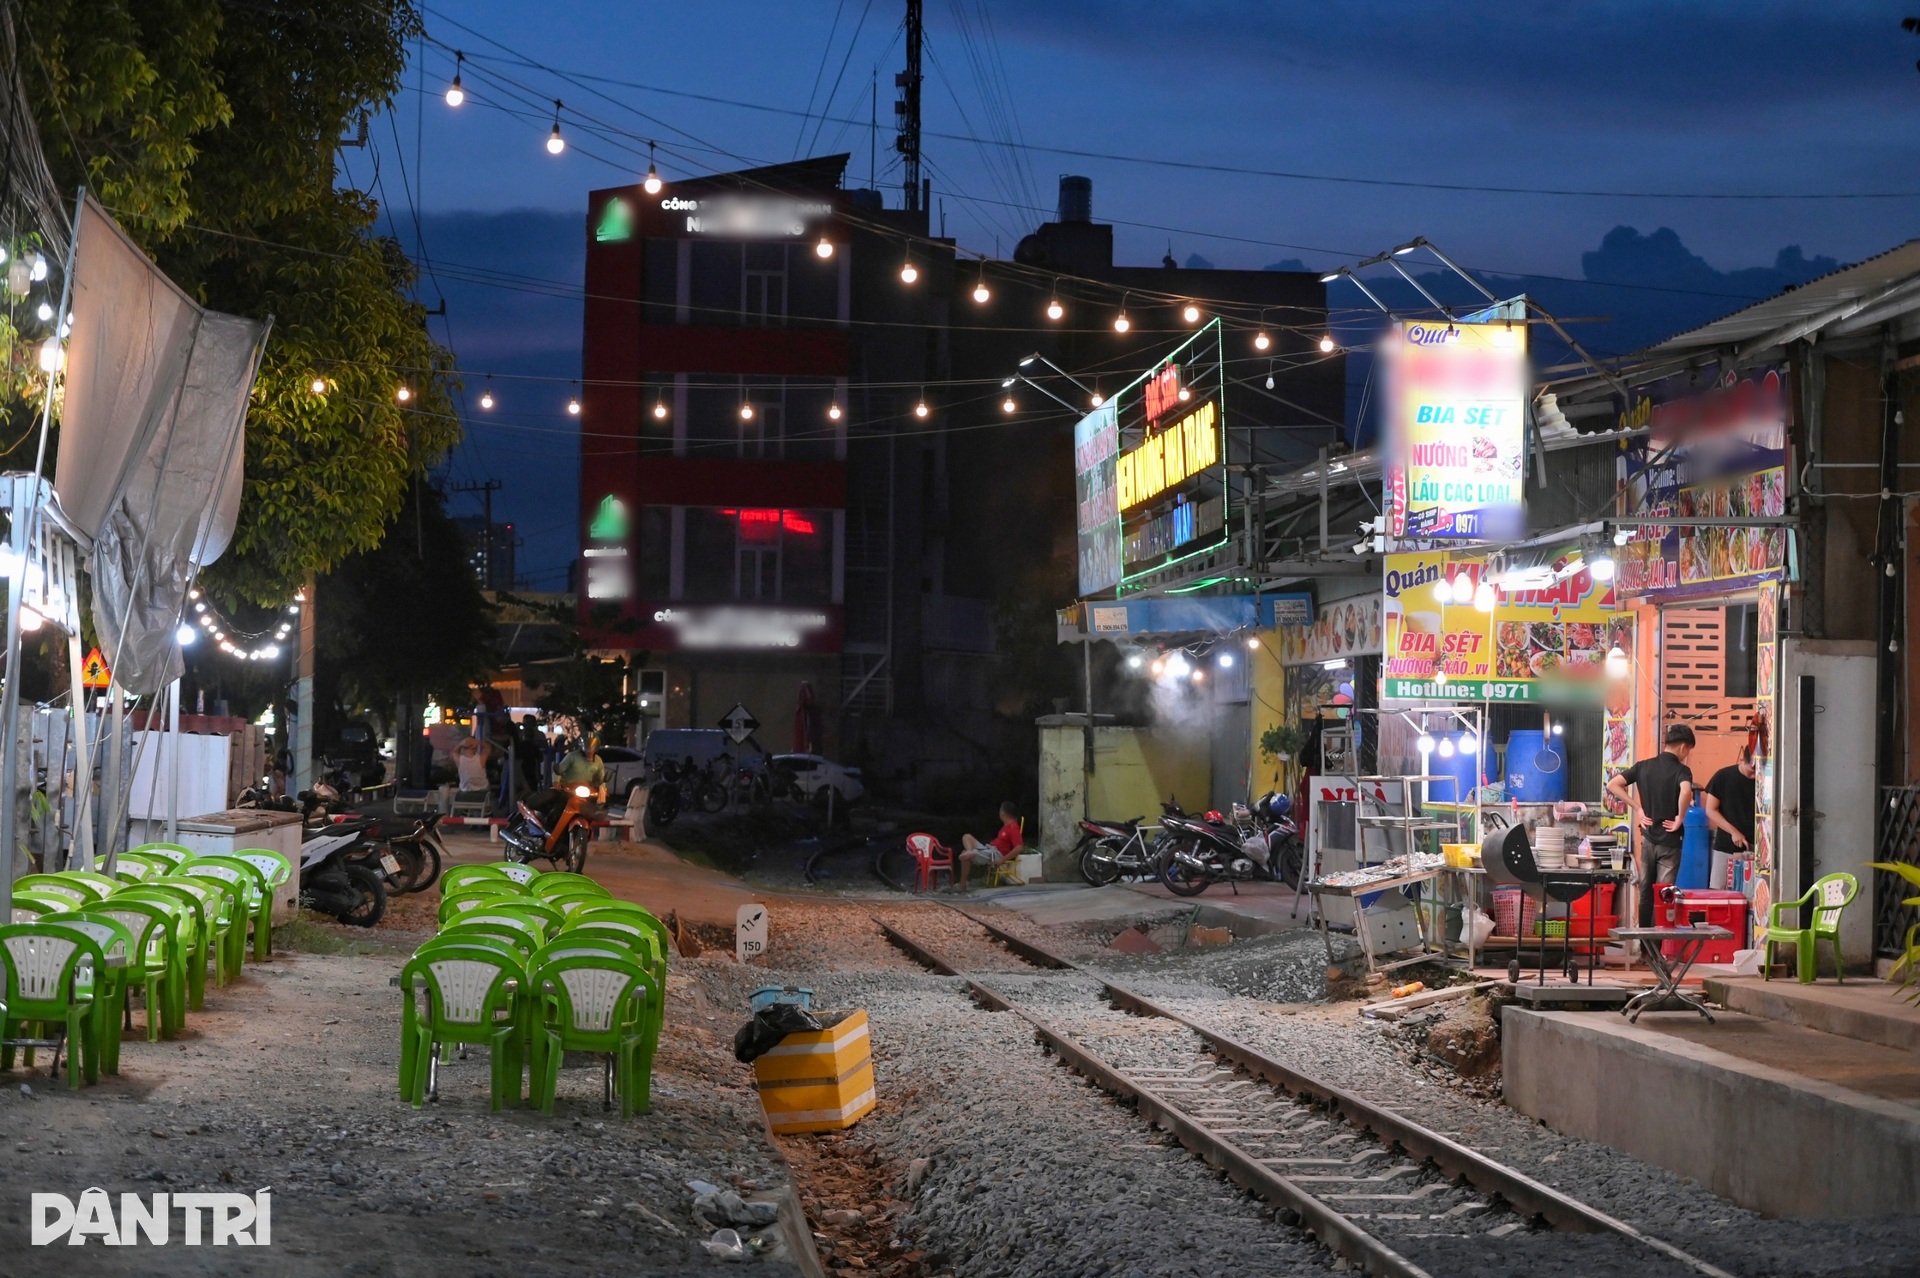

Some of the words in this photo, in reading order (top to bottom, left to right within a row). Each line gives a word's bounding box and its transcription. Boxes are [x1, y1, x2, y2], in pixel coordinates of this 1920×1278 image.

[661, 197, 698, 210] CÔNG
[1416, 406, 1456, 424] BIA
[1412, 440, 1468, 468] NƯỚNG
[1412, 474, 1440, 502] LẨU
[1455, 513, 1479, 534] 0971
[1386, 562, 1439, 597] Quán
[1399, 632, 1436, 653] BIA
[1442, 630, 1483, 659] SỆT
[1389, 656, 1432, 675] NƯỚNG
[1397, 681, 1476, 697] Hotline:
[1482, 683, 1529, 698] 0971
[741, 919, 755, 932] 11
[742, 941, 761, 951] 150
